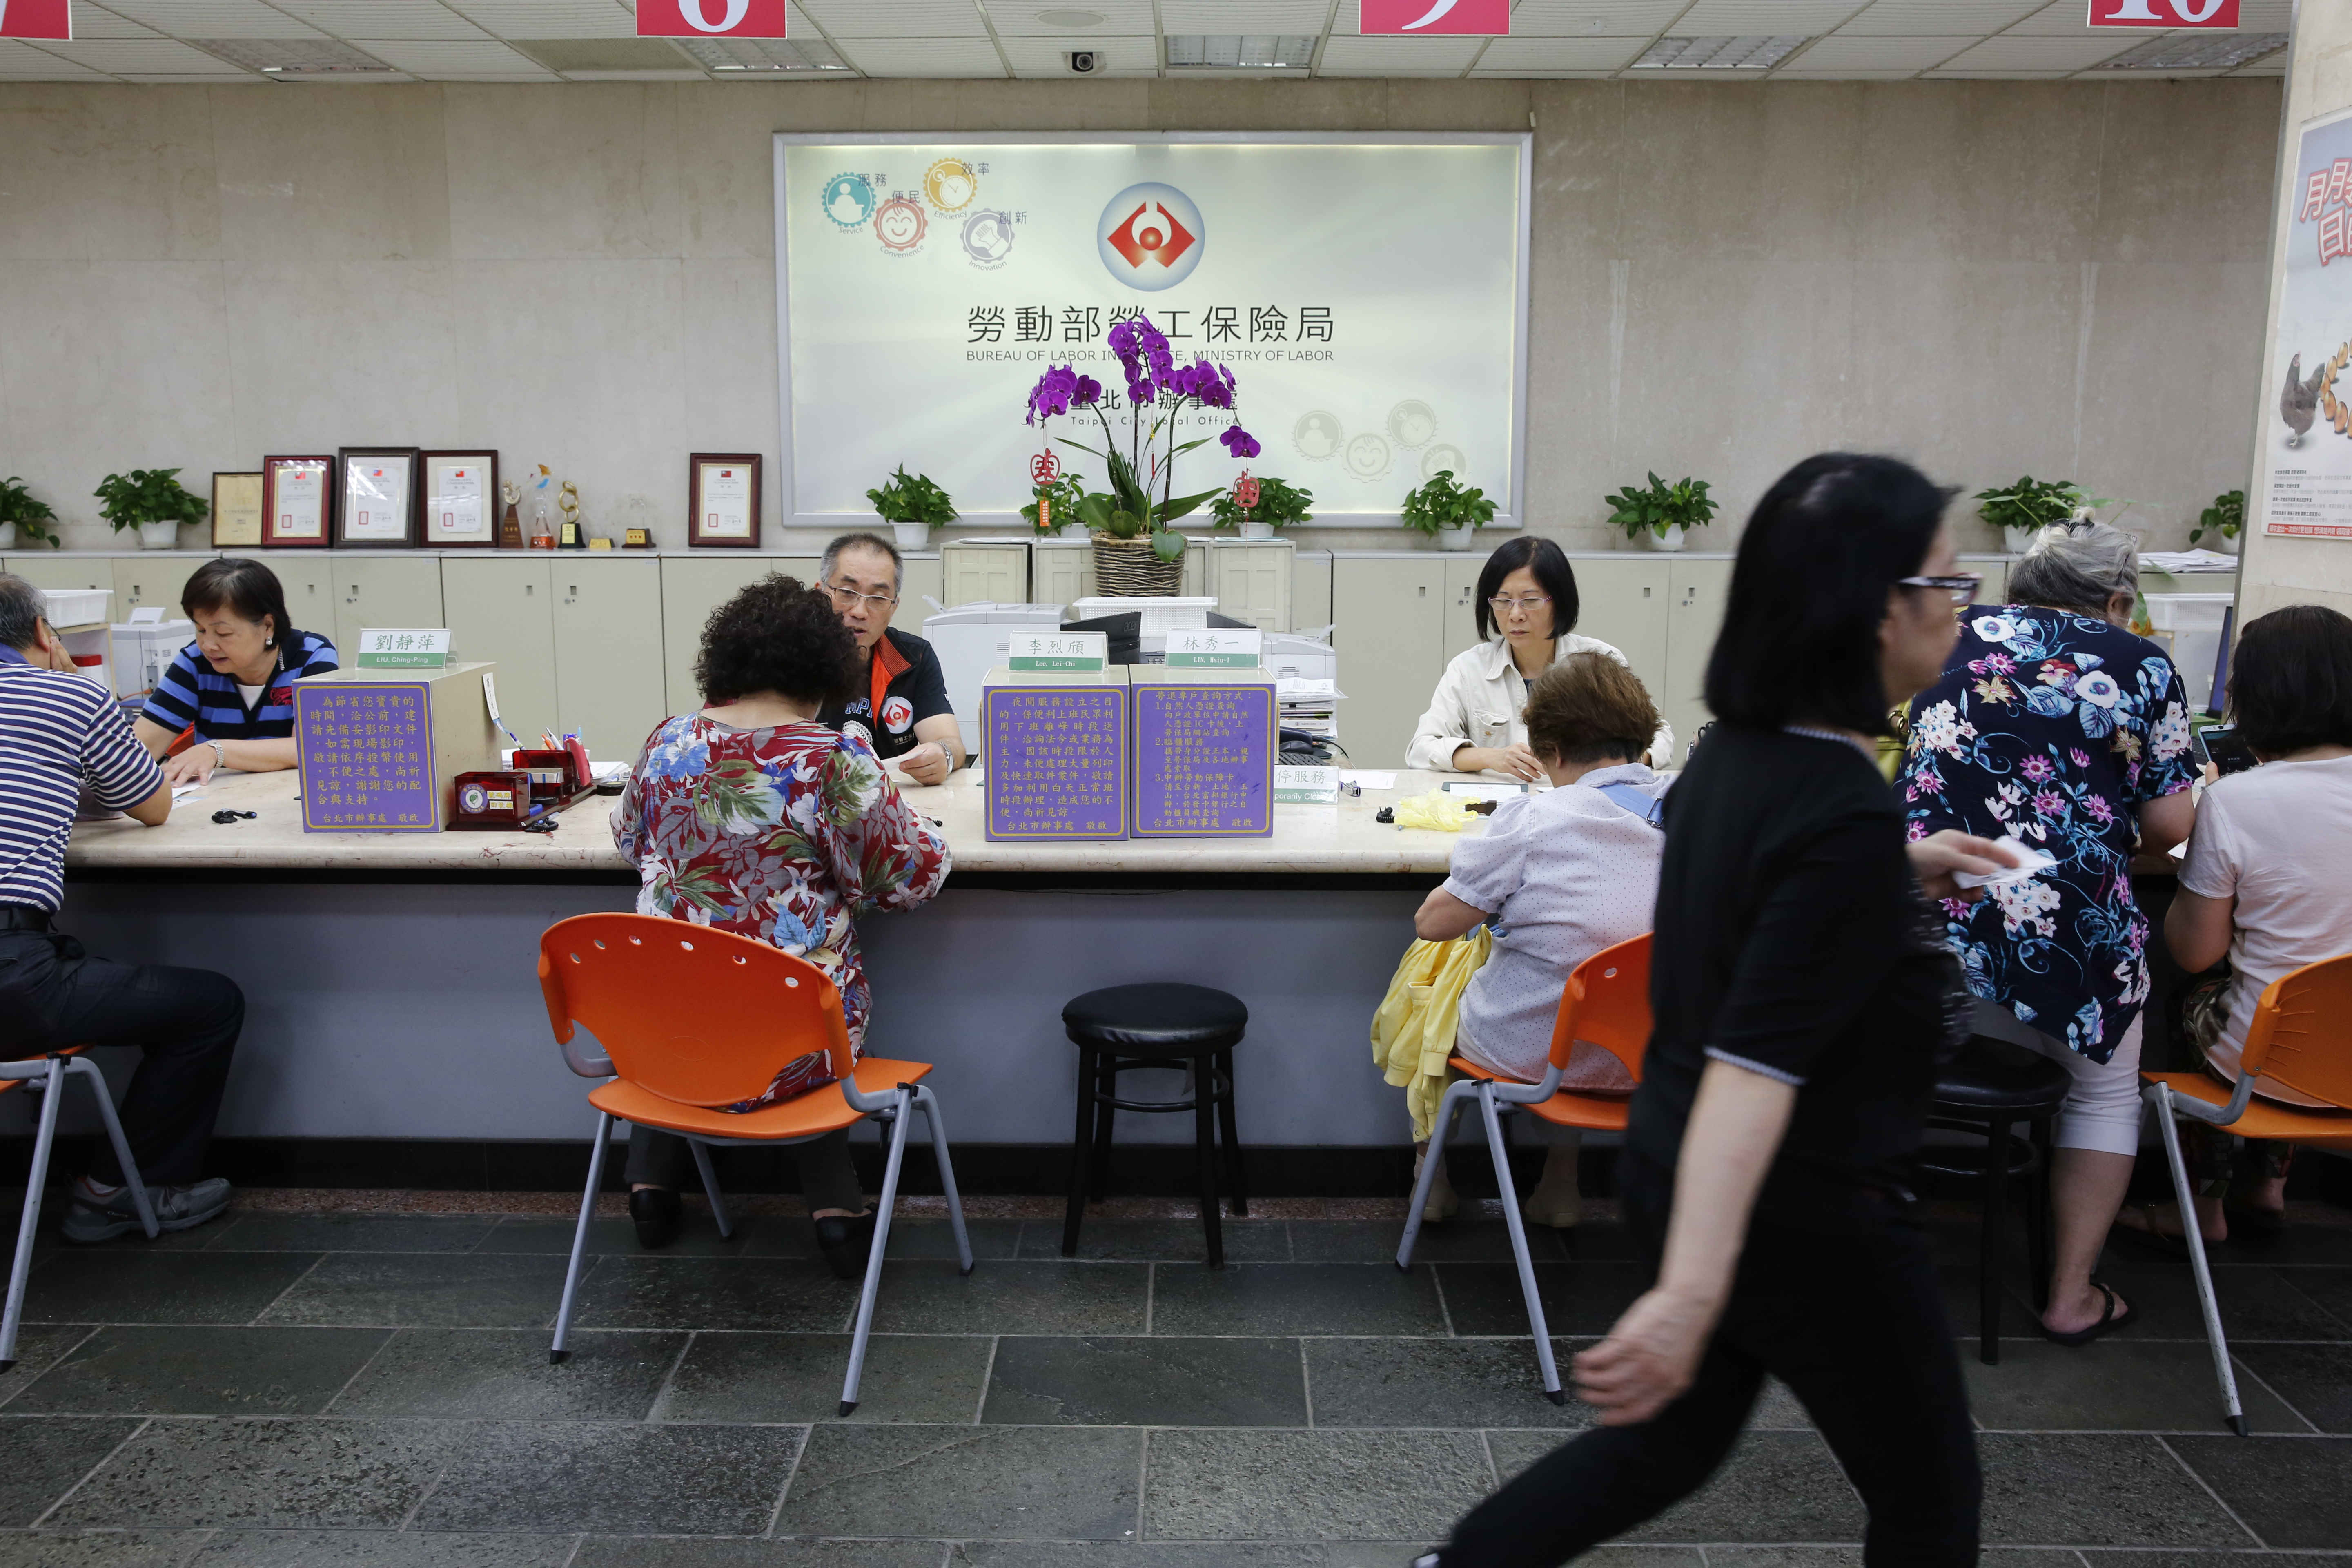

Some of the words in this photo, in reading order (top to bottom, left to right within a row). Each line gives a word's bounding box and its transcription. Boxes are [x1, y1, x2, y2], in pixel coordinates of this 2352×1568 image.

[961, 162, 989, 176] 效率
[858, 173, 887, 187] 服務
[891, 190, 920, 204] 便民
[934, 210, 968, 220] Efficiency
[998, 211, 1027, 225] 創新
[838, 226, 864, 234] Service
[880, 245, 924, 258] Convenience
[969, 259, 1007, 272] Innovation
[967, 350, 1022, 361] BUREAU
[1027, 350, 1045, 361] OF
[1051, 350, 1096, 361] LABOR
[1194, 350, 1261, 361] MINISTRY
[1265, 350, 1284, 361] OF
[1288, 350, 1334, 361] LABOR
[1121, 416, 1146, 427] Ciy
[1156, 416, 1189, 425] Loal
[1198, 416, 1238, 425] Office
[375, 633, 435, 651] 劉靜萍
[1183, 635, 1239, 651] 林秀一
[323, 695, 414, 708] 為節省您寶貴的
[1012, 697, 1112, 707] 夜間服務設立之目
[1165, 710, 1249, 719] 向戶政單位申請自然
[311, 724, 417, 735] 請先備妥影印文件
[1000, 722, 1114, 732] 用下班離峰時段送
[313, 751, 419, 763] 敬請依序投幣使用
[1164, 756, 1248, 764] 至勞保局及各地辦事
[1276, 769, 1327, 784] 停服務
[1001, 783, 1114, 793] 多加利用白天正常班
[317, 793, 378, 806] 合與支持。
[323, 813, 388, 823] 台北市辦事處
[1154, 818, 1220, 828] 台北市辦事處
[1007, 821, 1074, 831] 台北市辦事處
